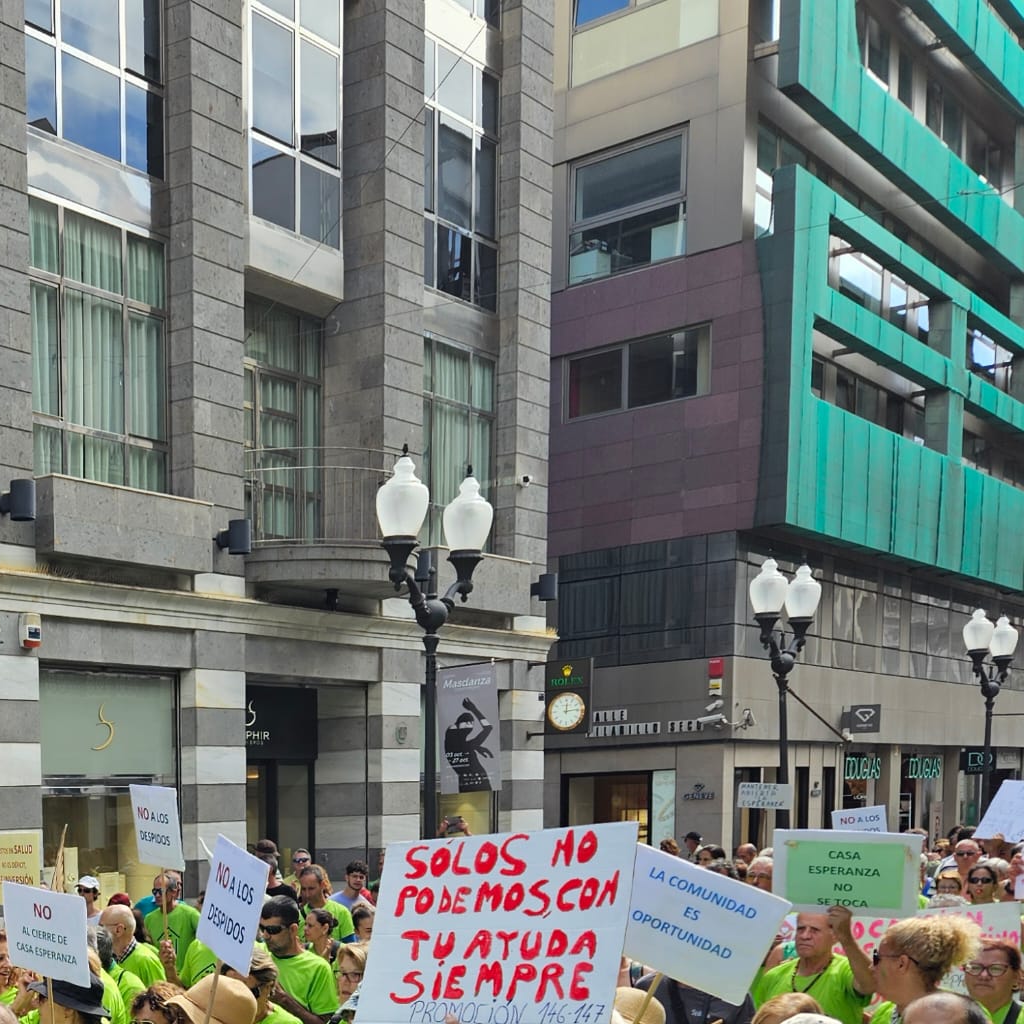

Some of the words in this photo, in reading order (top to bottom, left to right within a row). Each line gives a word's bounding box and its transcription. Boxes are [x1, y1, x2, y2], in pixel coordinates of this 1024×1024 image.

[443, 677, 491, 689] Masdanza
[551, 676, 585, 687] ROLEX
[594, 711, 626, 721] ALLE
[844, 757, 881, 780] DOUGLAS
[908, 757, 941, 779] DOUGLAS
[137, 806, 149, 820] NO
[150, 811, 156, 821] A
[157, 812, 169, 824] LOS
[840, 817, 855, 825] NO
[140, 830, 170, 846] DESPIDOS
[14, 845, 32, 854] SALUD
[551, 830, 598, 867] NO
[828, 850, 861, 861] CASA
[808, 865, 881, 878] ESPERANZA
[215, 862, 230, 889] NO
[229, 881, 237, 895] A
[236, 884, 254, 905] LOS
[556, 870, 620, 912] CON
[833, 882, 853, 893] NO
[649, 866, 666, 883] LA
[668, 875, 757, 919] COMUNIDAD
[33, 903, 52, 920] NO
[817, 898, 834, 907] SE
[836, 898, 868, 909] TOCA
[684, 907, 700, 921] ES
[207, 904, 245, 945] DESPIDOS
[22, 926, 30, 936] AL
[31, 929, 57, 944] CIERRE
[58, 935, 68, 946] DE
[632, 910, 732, 960] OPORTUNIDAD
[16, 941, 34, 953] CASA
[35, 945, 77, 966] ESPERANZA
[401, 930, 455, 961] TU
[463, 929, 597, 960] AYUDA
